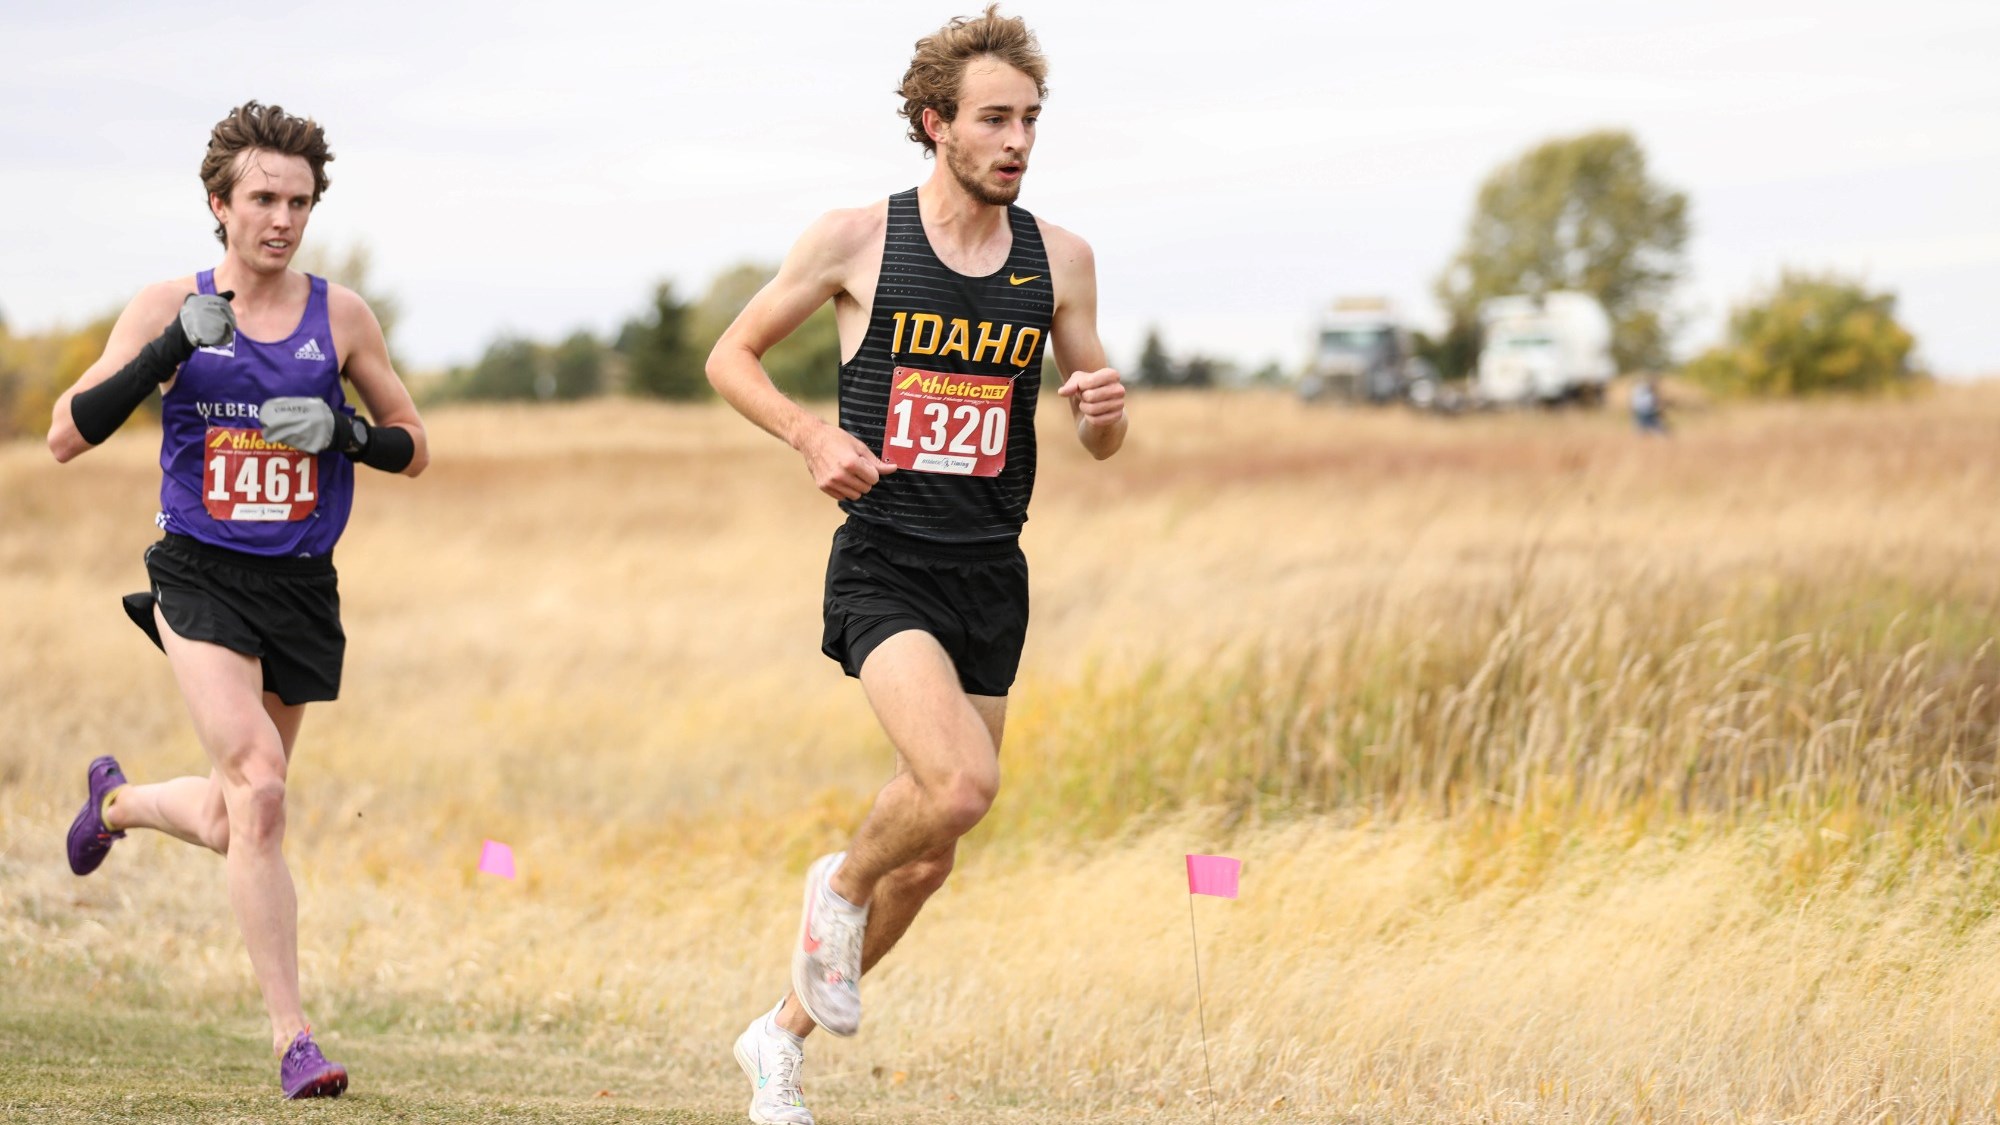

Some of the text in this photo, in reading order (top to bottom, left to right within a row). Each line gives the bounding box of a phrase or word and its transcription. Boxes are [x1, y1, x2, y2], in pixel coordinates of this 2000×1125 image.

[294, 351, 326, 362] adidas
[891, 312, 1041, 368] IDAHO
[896, 372, 982, 398] Athletic
[983, 388, 1005, 397] NET
[196, 401, 259, 419] WEBER
[889, 399, 1007, 456] 1320
[207, 455, 315, 503] 1461
